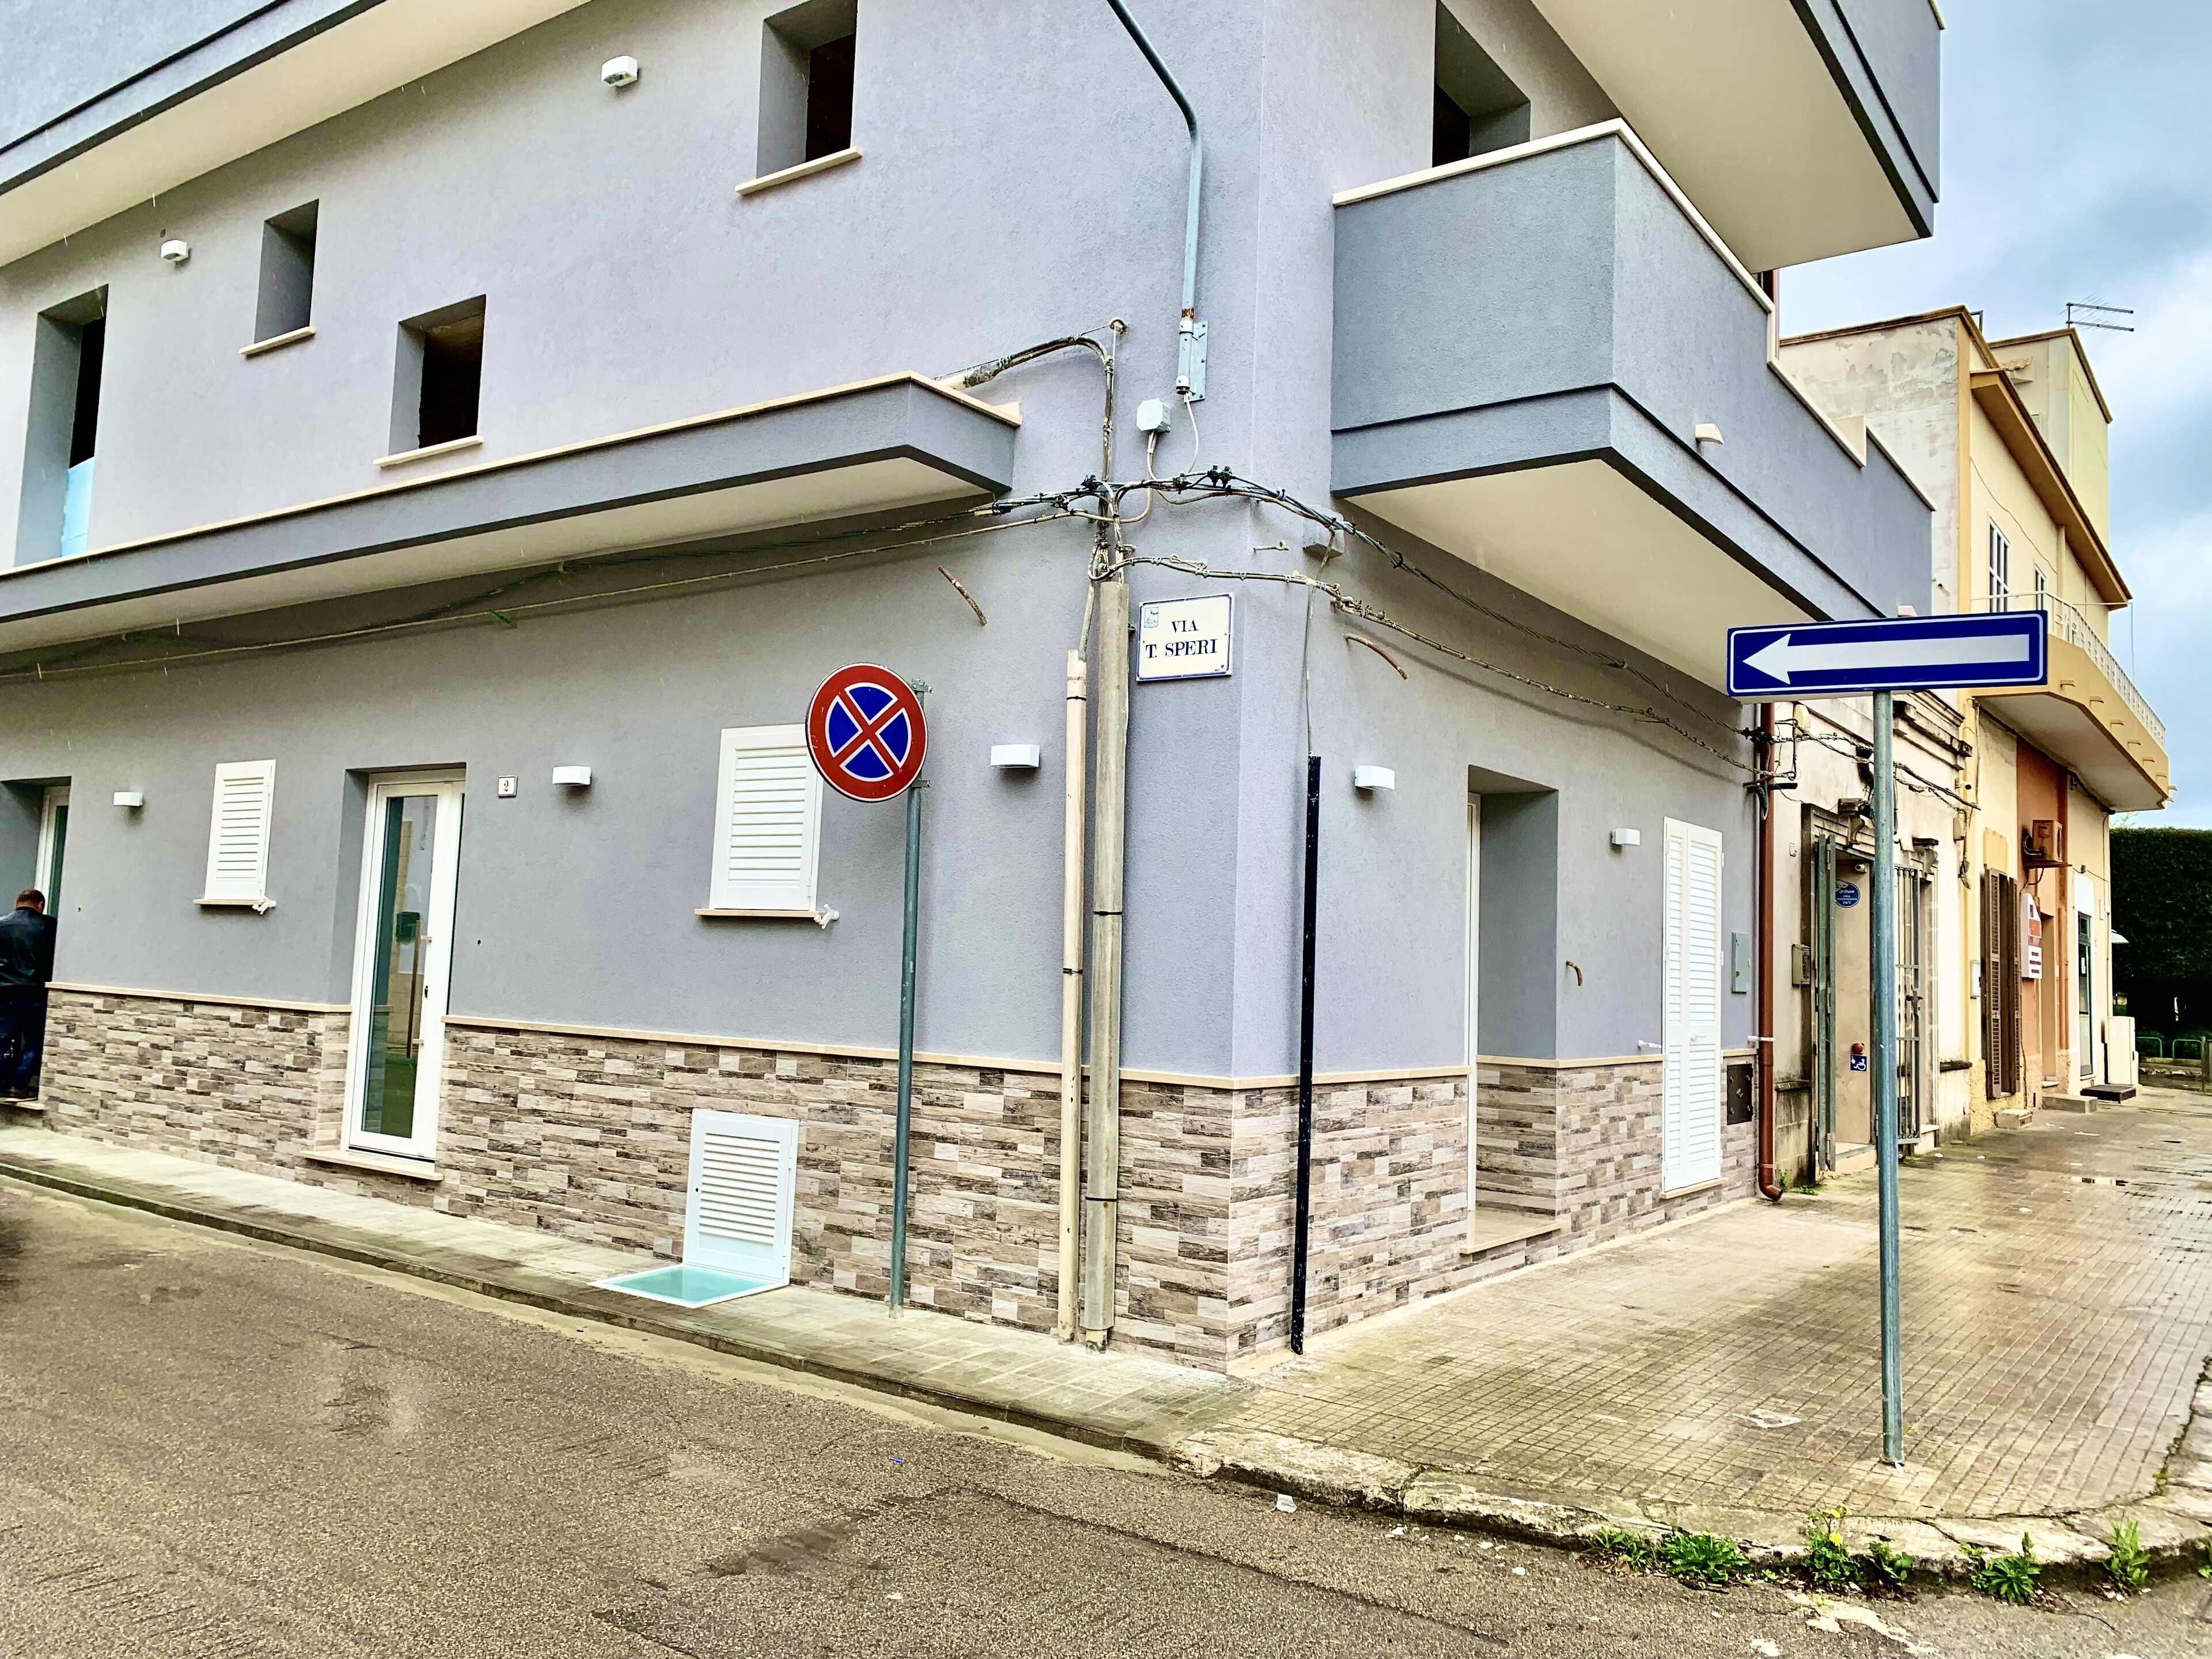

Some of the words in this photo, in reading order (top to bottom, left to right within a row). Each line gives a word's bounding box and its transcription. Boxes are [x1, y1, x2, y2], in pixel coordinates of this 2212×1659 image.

[1172, 620, 1199, 632] VIA
[1145, 643, 1157, 658] T.
[1165, 639, 1218, 657] SPERI
